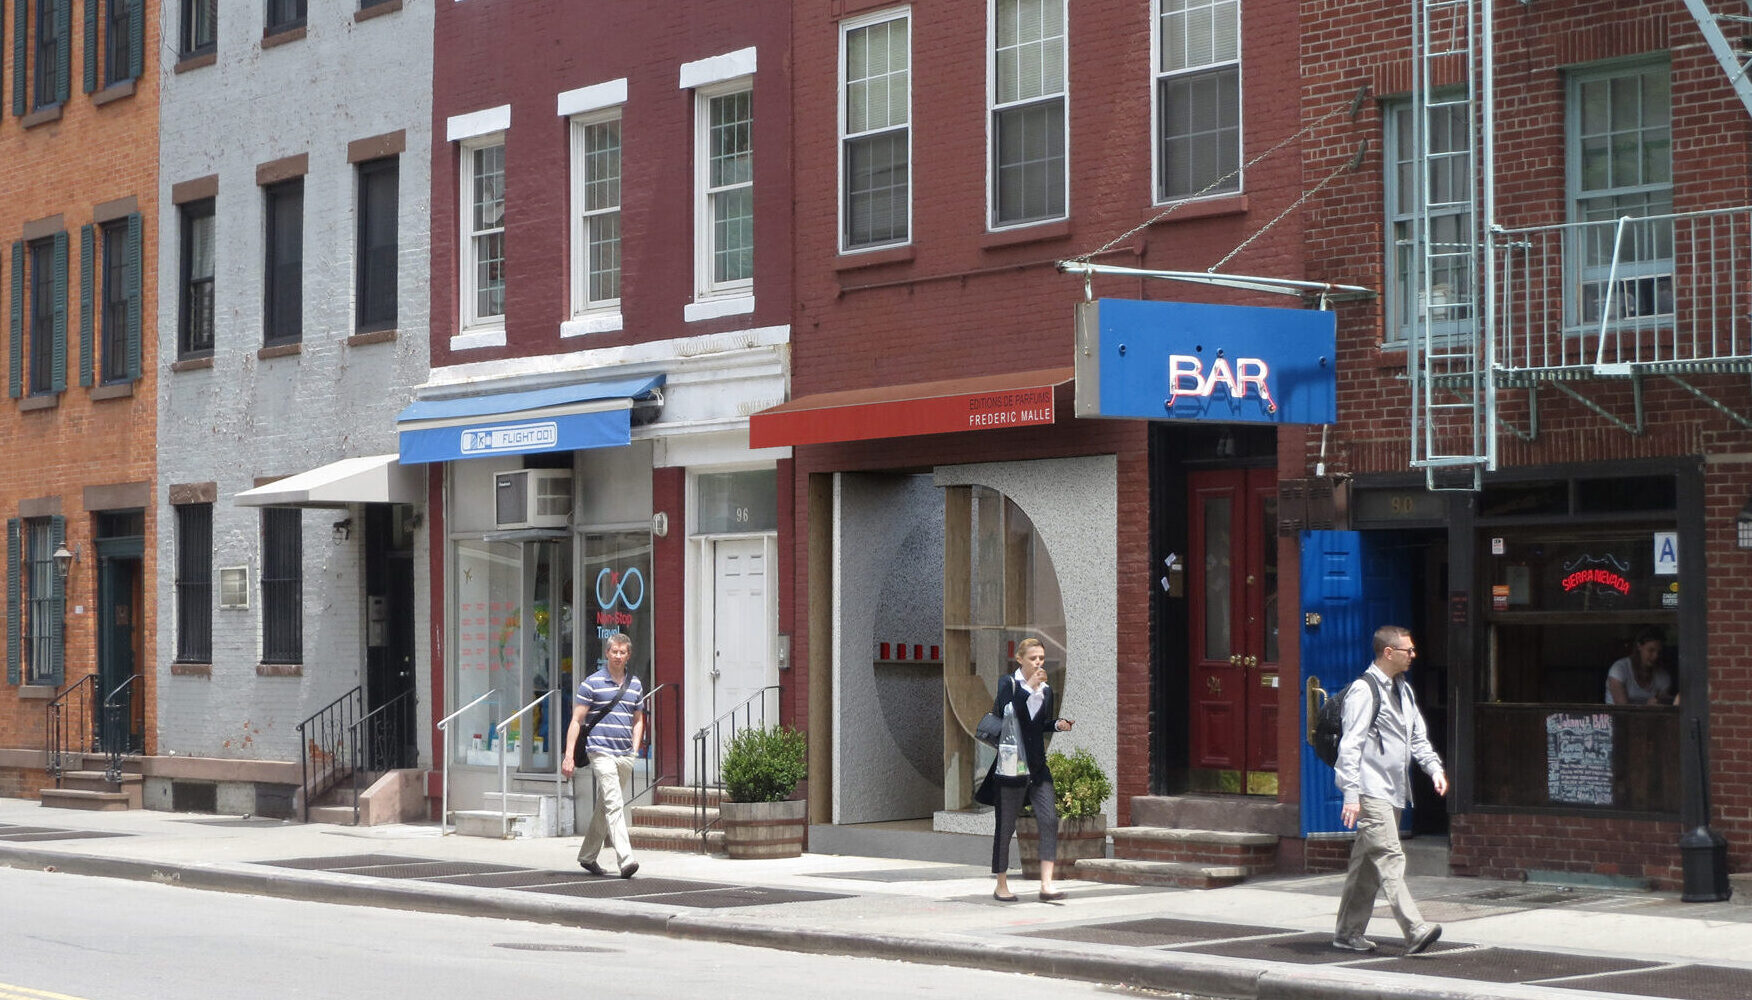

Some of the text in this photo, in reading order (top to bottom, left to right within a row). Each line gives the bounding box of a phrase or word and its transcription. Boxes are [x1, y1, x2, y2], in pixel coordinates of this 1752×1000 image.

[1169, 355, 1271, 400] BAR
[969, 391, 1051, 411] EDITIONS DE PARFUMS
[969, 408, 1051, 426] FREDERIC MALLE
[502, 431, 534, 444] FLIGHT
[536, 429, 553, 441] 001
[1391, 496, 1413, 513] 90
[736, 508, 749, 522] 96
[1659, 537, 1676, 562] A
[1561, 569, 1631, 596] SIERRA NEVADA
[596, 611, 633, 628] Non-Stop
